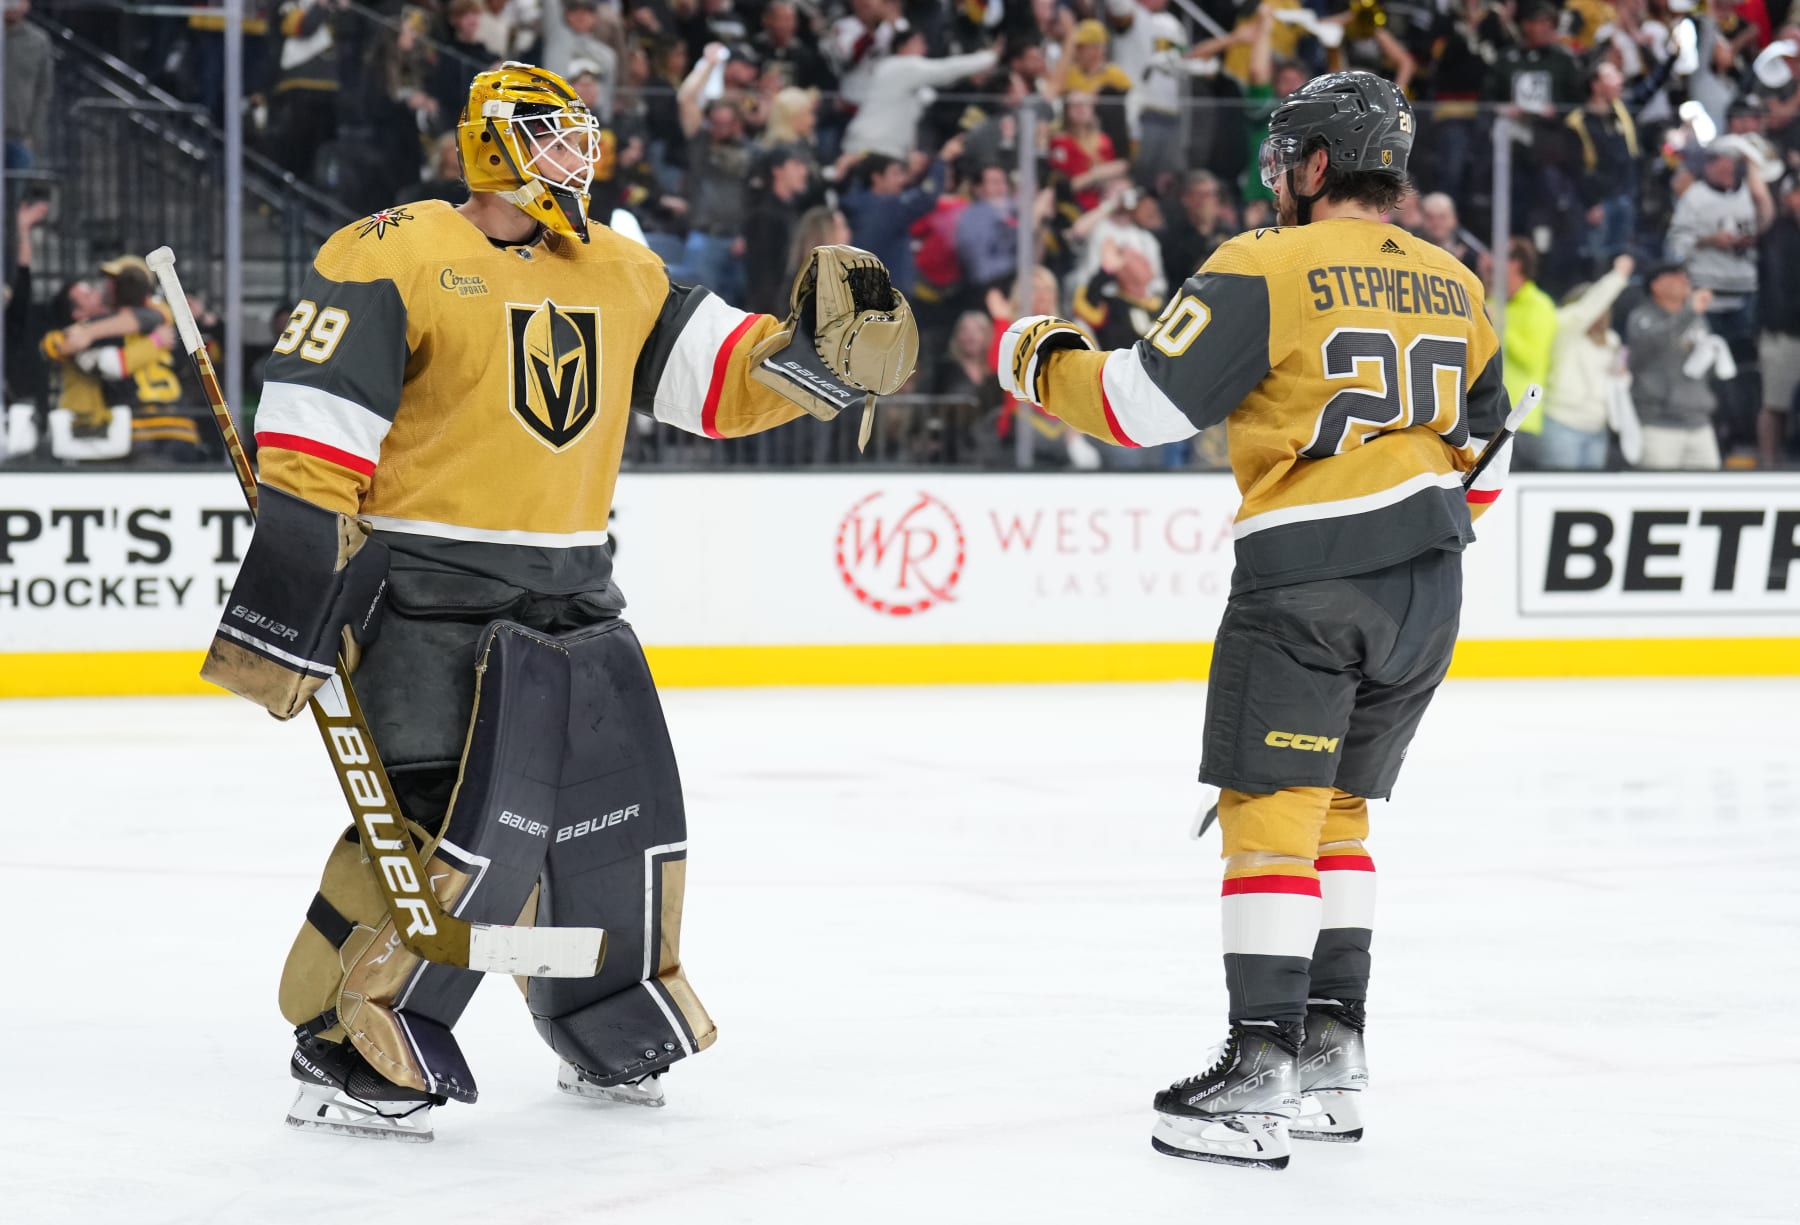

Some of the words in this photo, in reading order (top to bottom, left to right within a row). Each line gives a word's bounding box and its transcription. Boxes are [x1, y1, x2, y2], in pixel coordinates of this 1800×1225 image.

[440, 268, 483, 290] Circa
[459, 285, 488, 295] SPORTS
[273, 299, 350, 364] 39
[783, 361, 850, 398] BAUER
[1297, 327, 1471, 459] 20
[231, 604, 299, 642] BAUER
[1264, 731, 1340, 753] CCM
[327, 726, 438, 938] BAUER
[498, 810, 549, 839] BAUER
[555, 803, 641, 843] BAUER
[1188, 1080, 1226, 1105] BAUER
